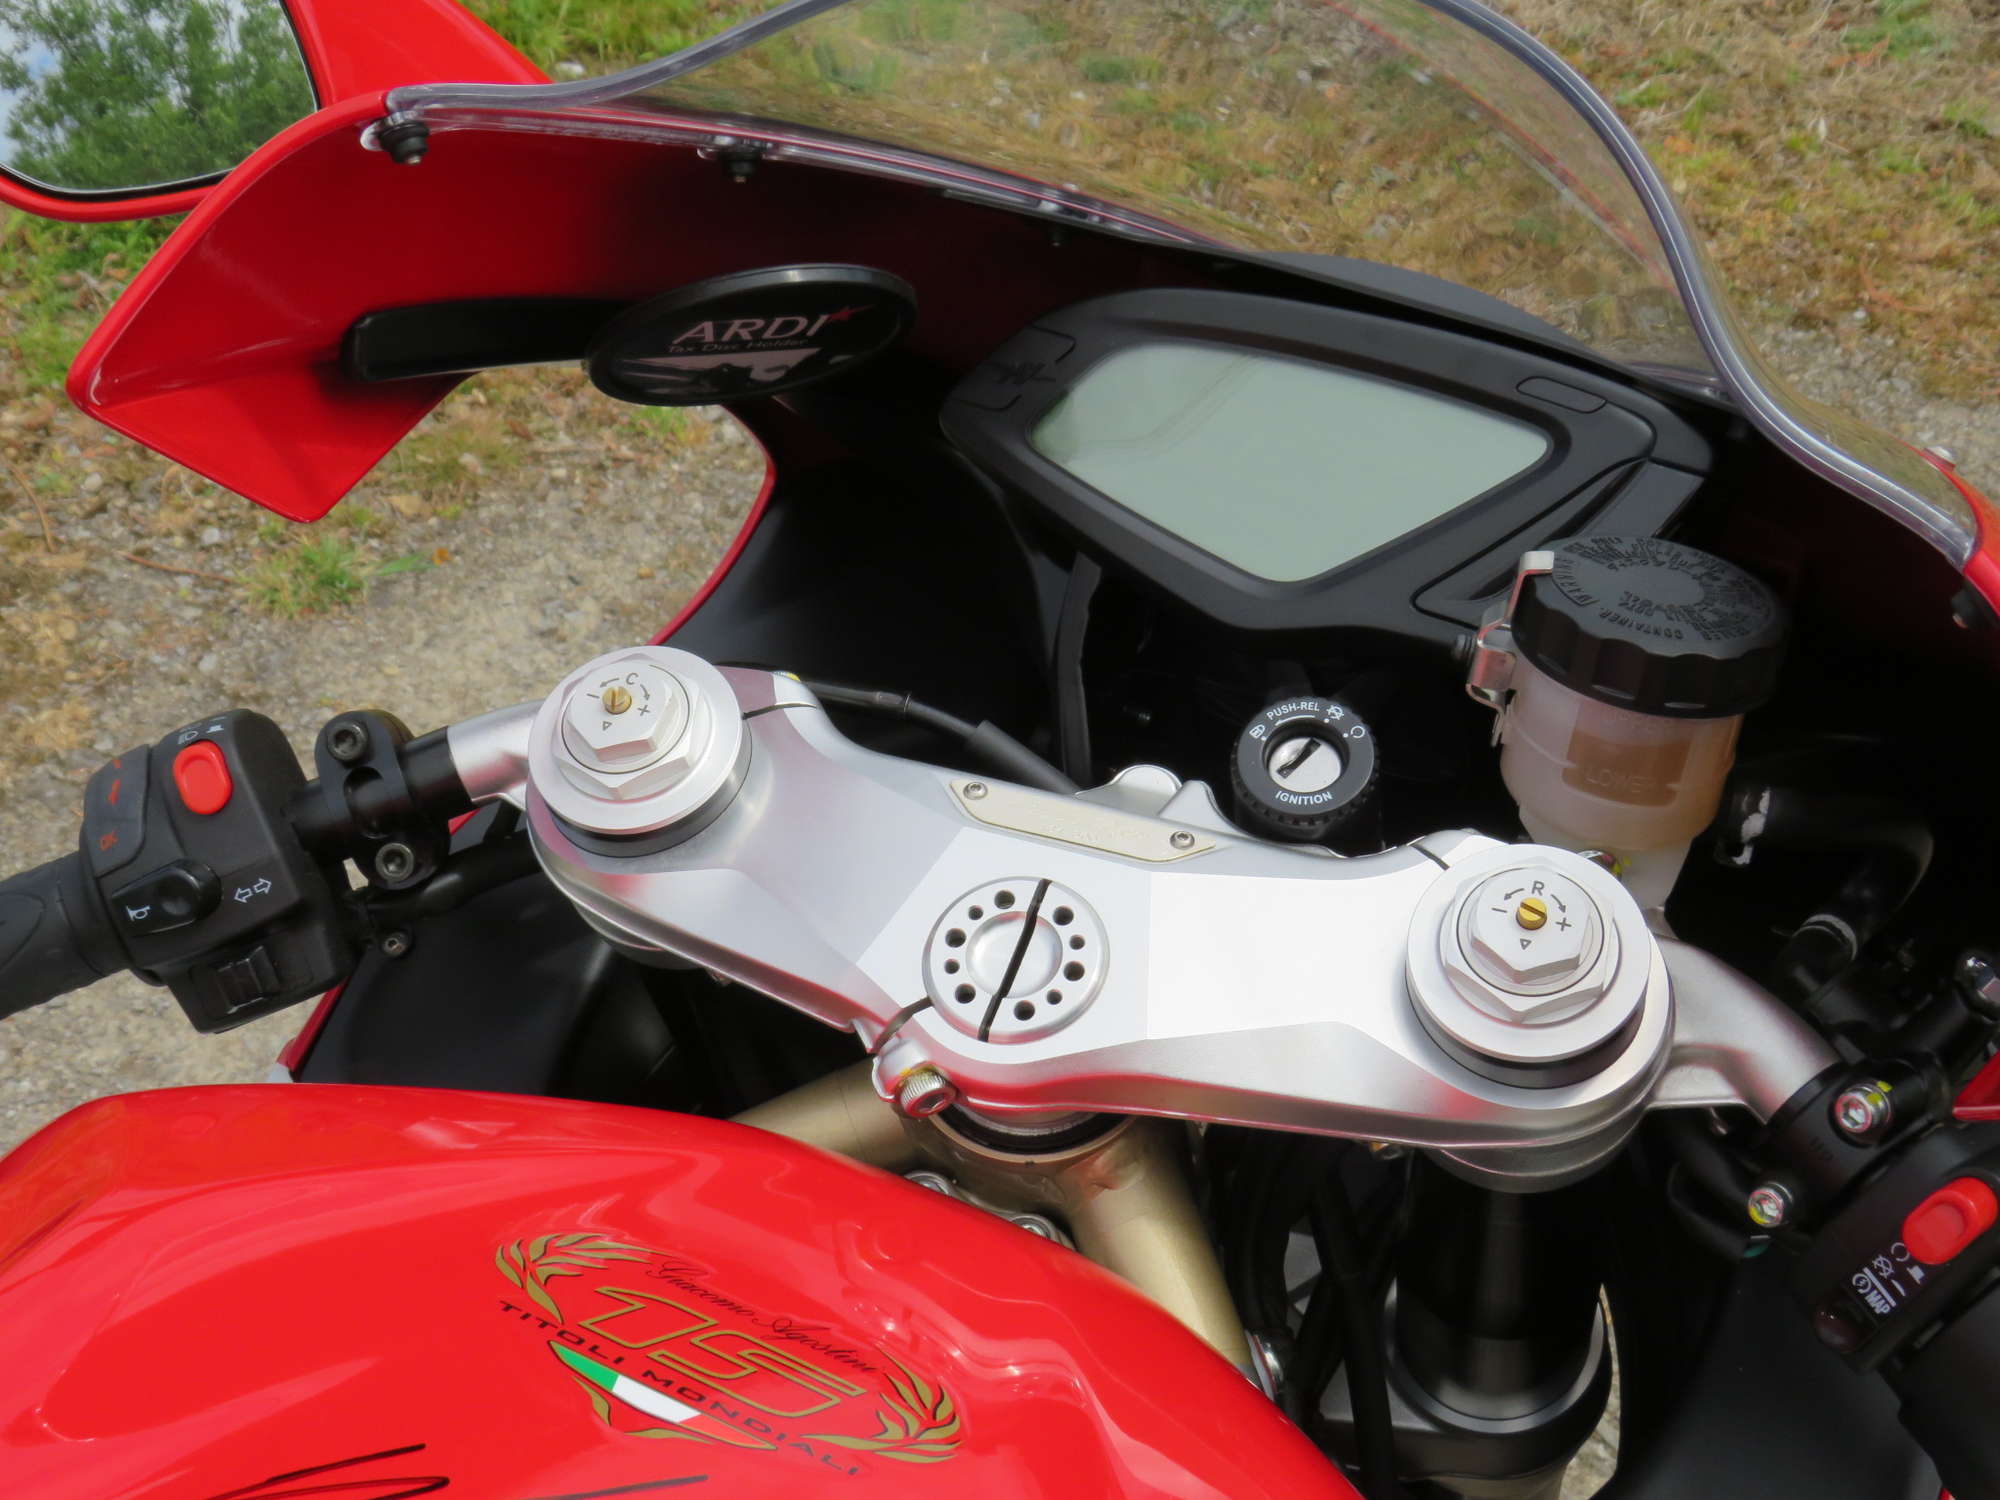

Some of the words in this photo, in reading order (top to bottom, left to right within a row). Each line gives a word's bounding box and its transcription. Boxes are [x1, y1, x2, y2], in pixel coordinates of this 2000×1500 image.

[625, 672, 639, 685] C
[1266, 701, 1320, 720] PUSH-REL
[1274, 790, 1333, 805] IGNITION
[1531, 880, 1545, 896] R
[1864, 1290, 1892, 1315] MAP
[500, 1301, 624, 1365] TITOLI
[642, 1369, 860, 1476] MONDIALI
